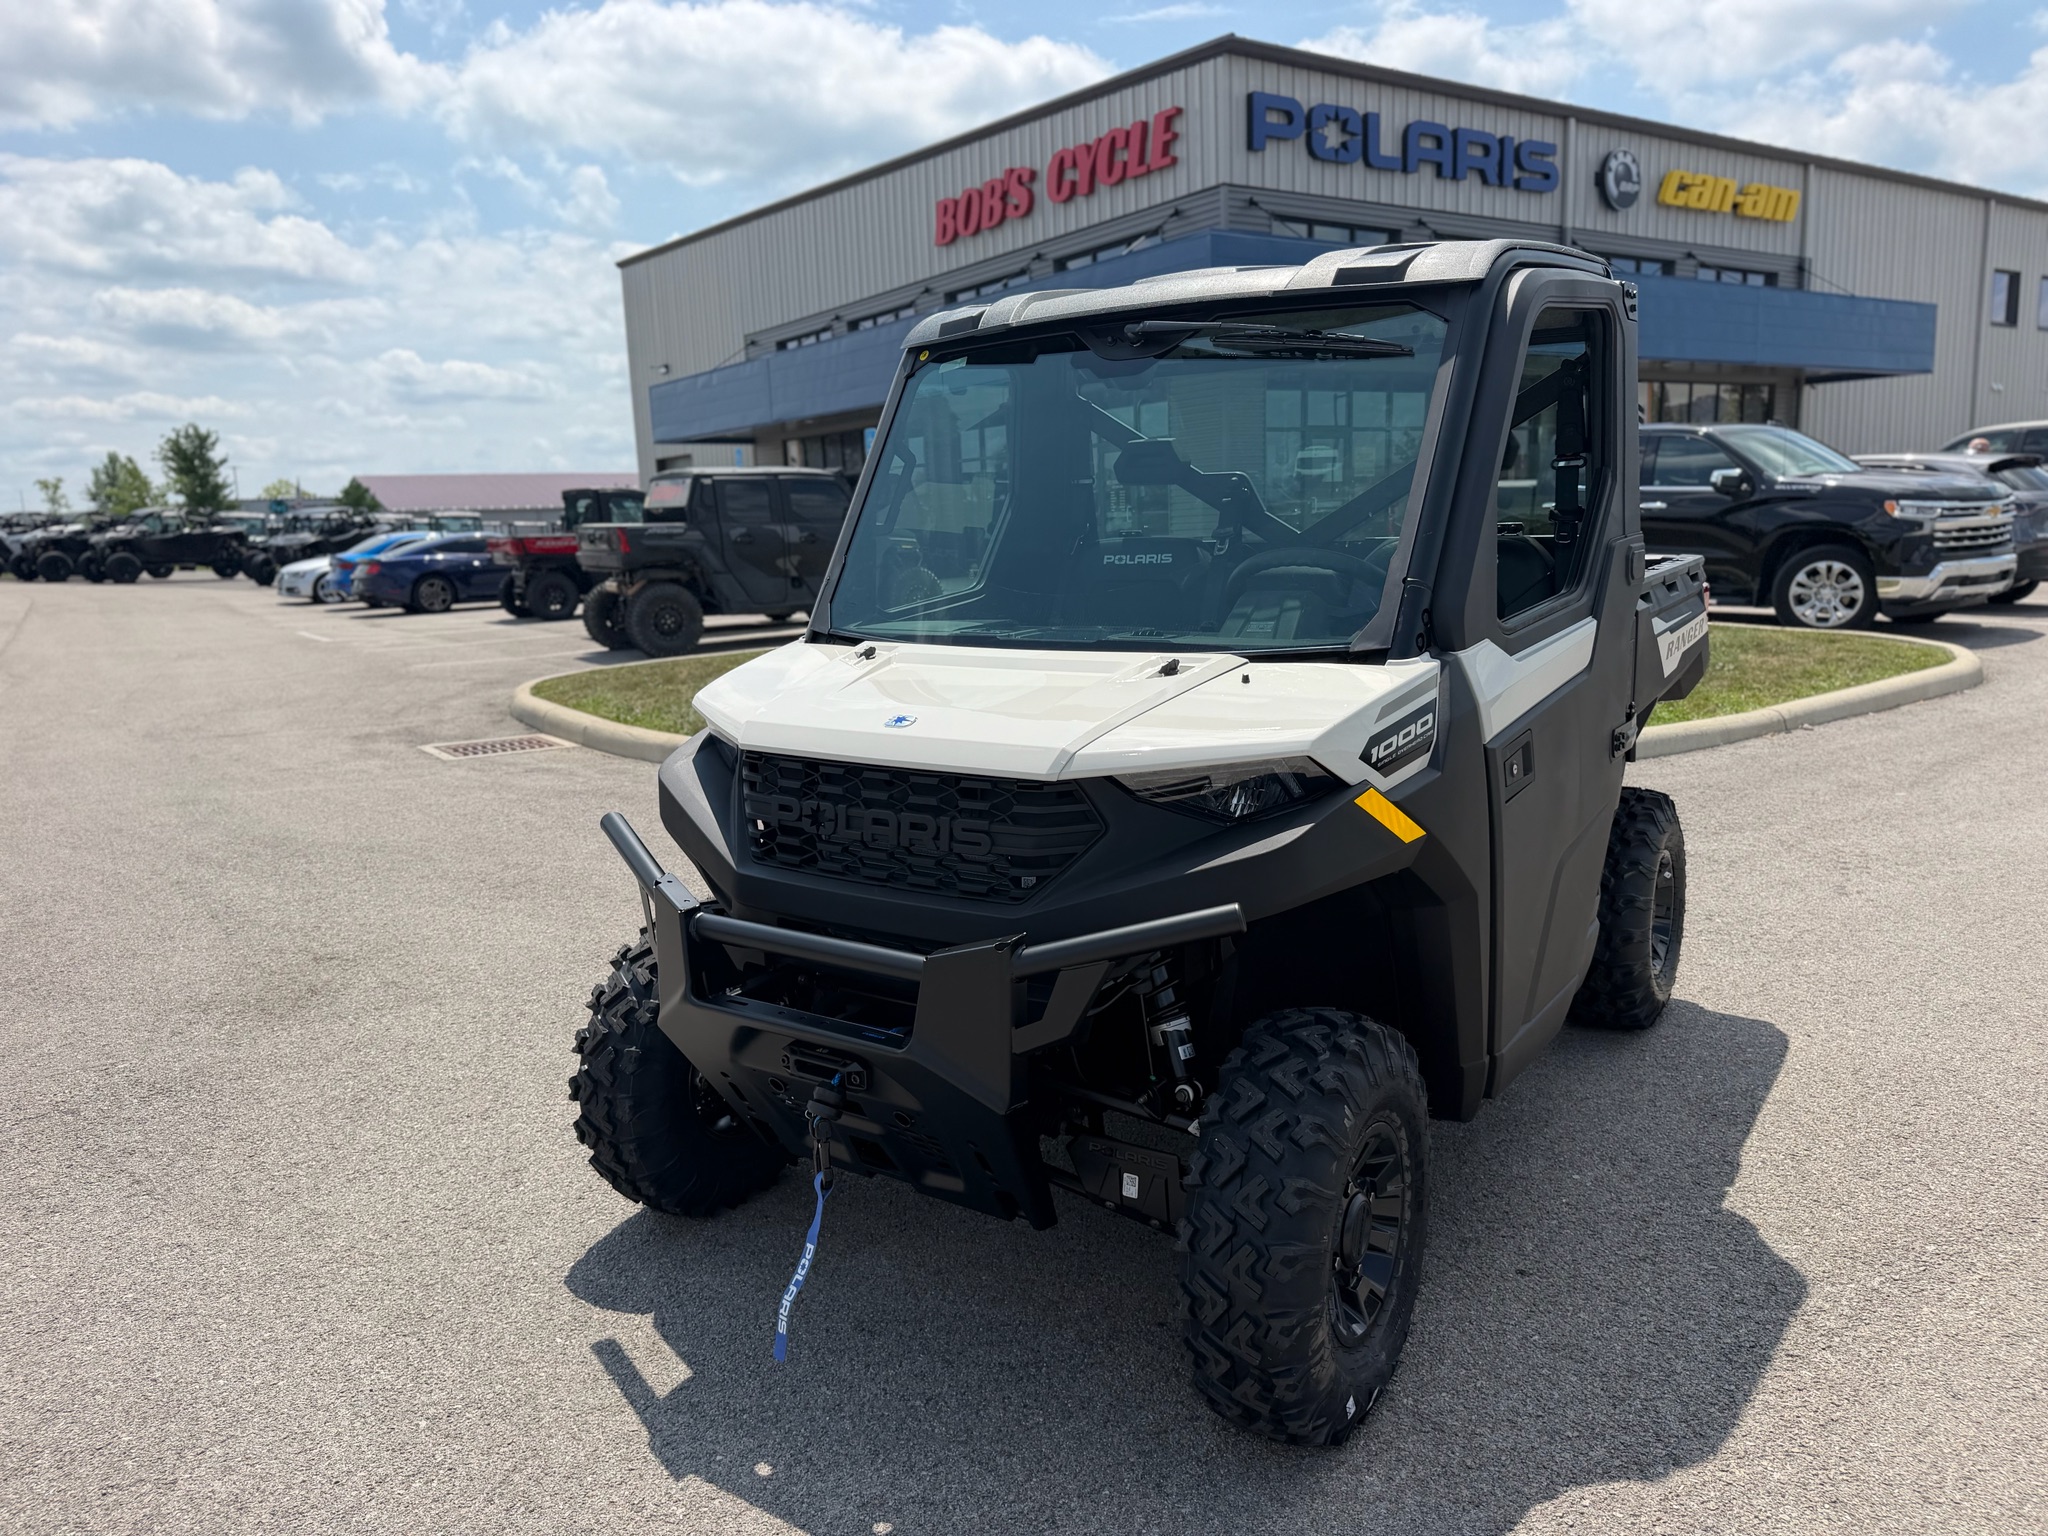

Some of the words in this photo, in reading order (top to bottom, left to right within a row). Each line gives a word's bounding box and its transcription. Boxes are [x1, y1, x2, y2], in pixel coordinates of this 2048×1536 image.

[1248, 91, 1558, 192] POLARIS
[934, 167, 1036, 247] BOB'S
[1047, 106, 1183, 204] CYCLE
[1103, 553, 1173, 565] POLARIS
[1665, 617, 1704, 661] RANGER
[1371, 712, 1433, 764] 1000
[771, 794, 993, 856] POLARIS
[1088, 1142, 1168, 1171] POLARIS
[778, 1242, 815, 1335] POLARIS
